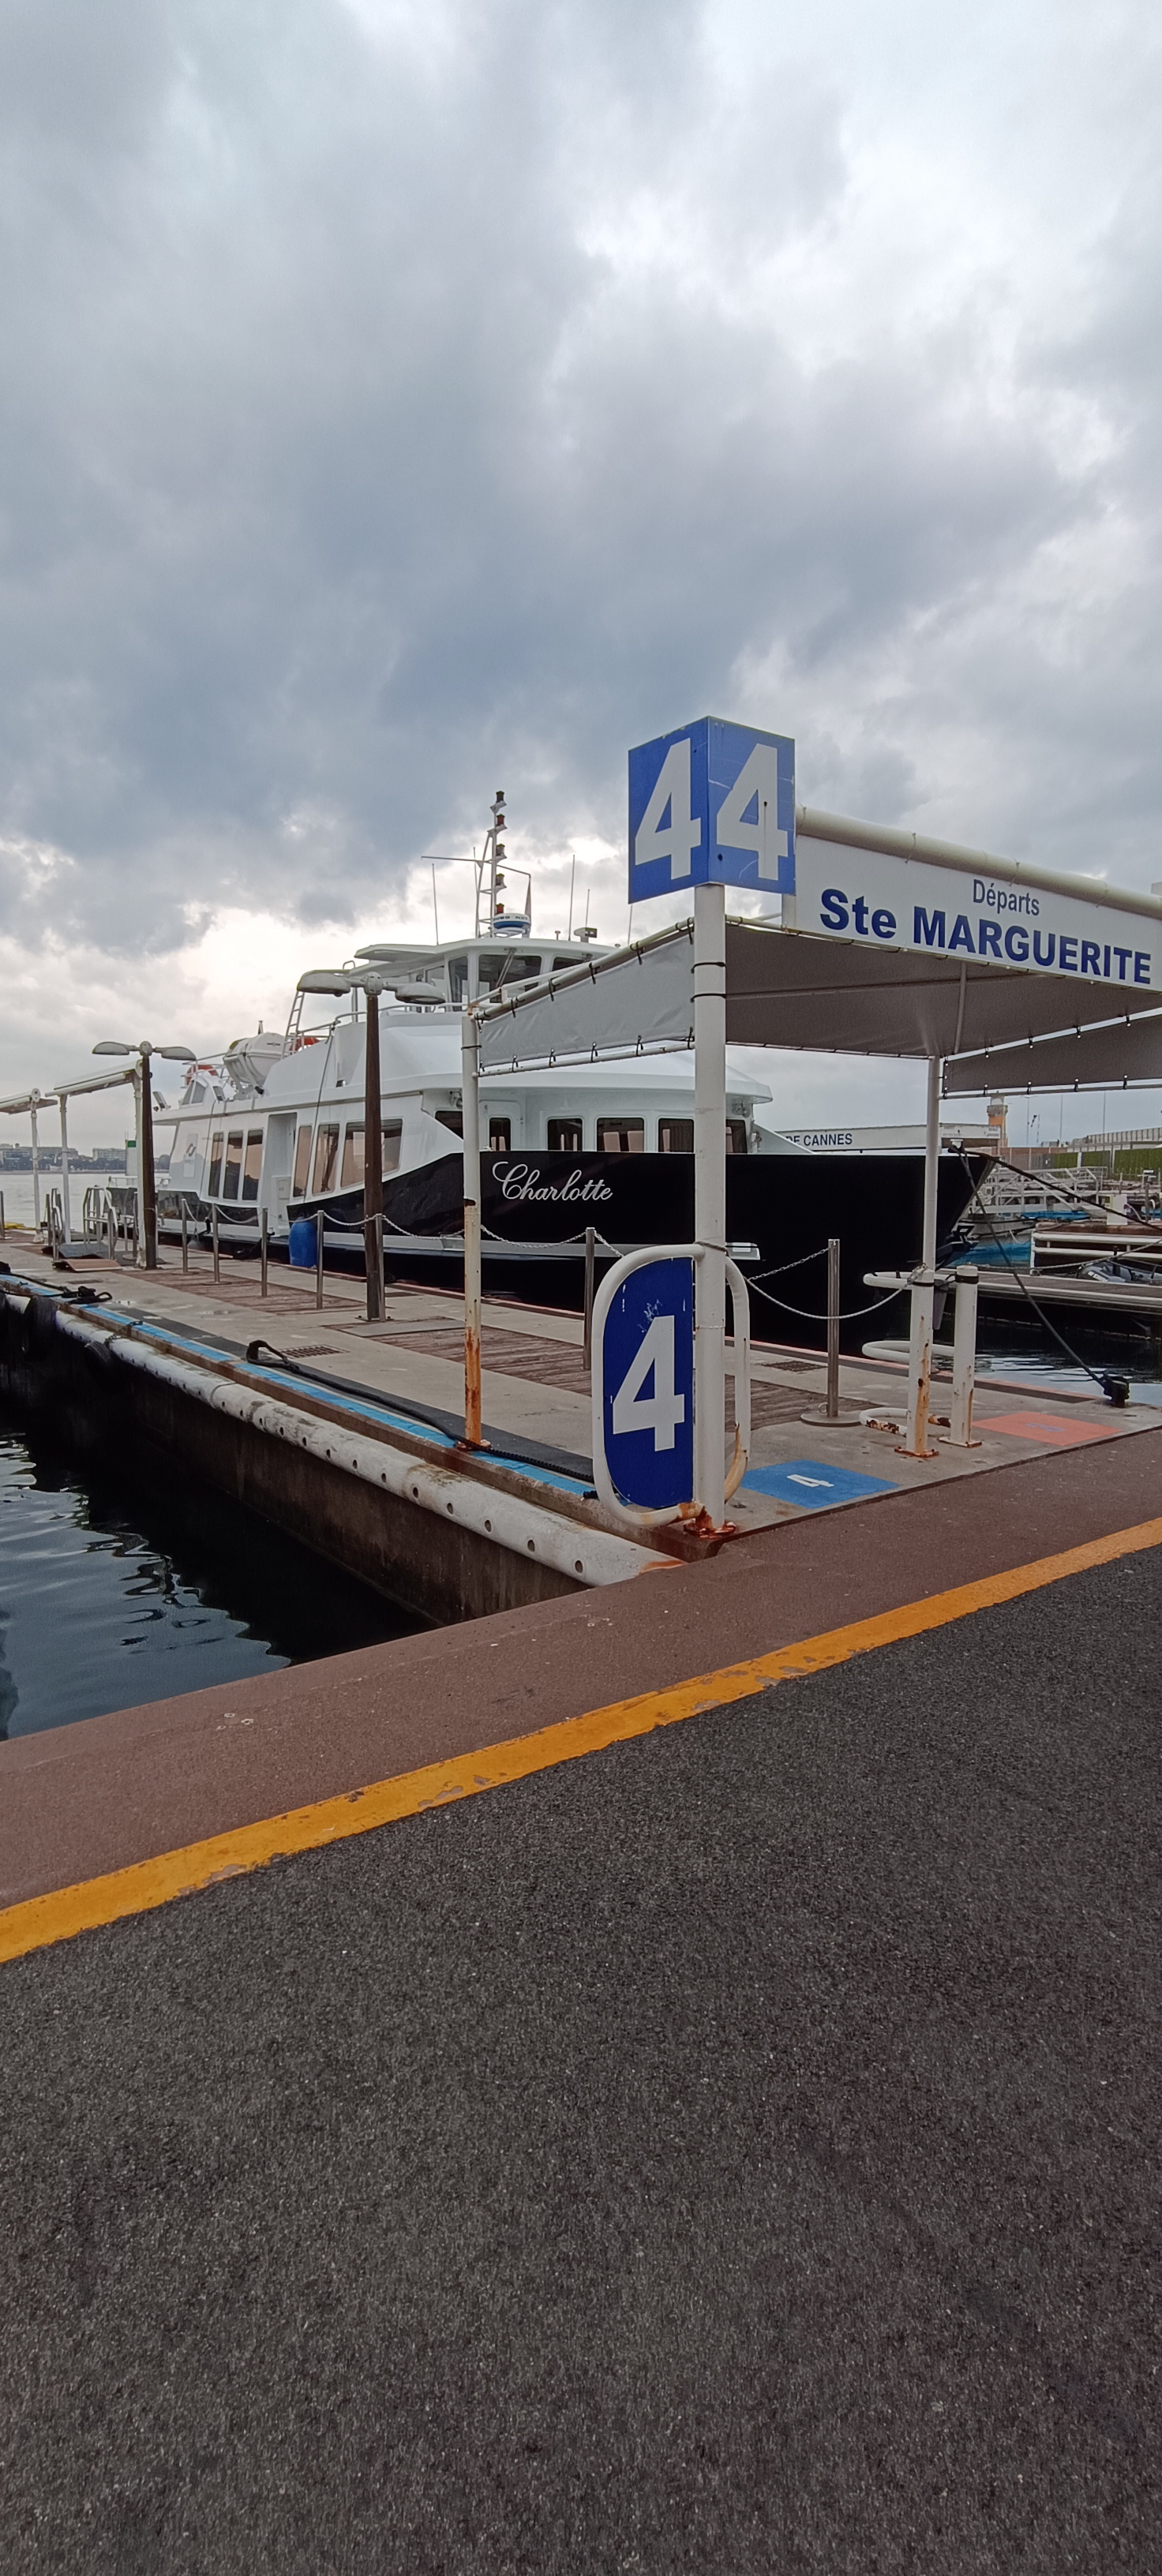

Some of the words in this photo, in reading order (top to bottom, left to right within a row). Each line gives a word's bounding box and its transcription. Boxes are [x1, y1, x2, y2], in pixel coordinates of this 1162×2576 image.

[635, 737, 701, 880] 4
[717, 743, 788, 881] 4
[973, 879, 1040, 915] Départs
[820, 889, 897, 938] Ste
[913, 905, 1151, 985] MARGUERITE
[804, 1133, 853, 1146] CANNES
[492, 1161, 613, 1200] Charlotte
[613, 1315, 684, 1451] 4
[786, 1473, 834, 1488] 4
